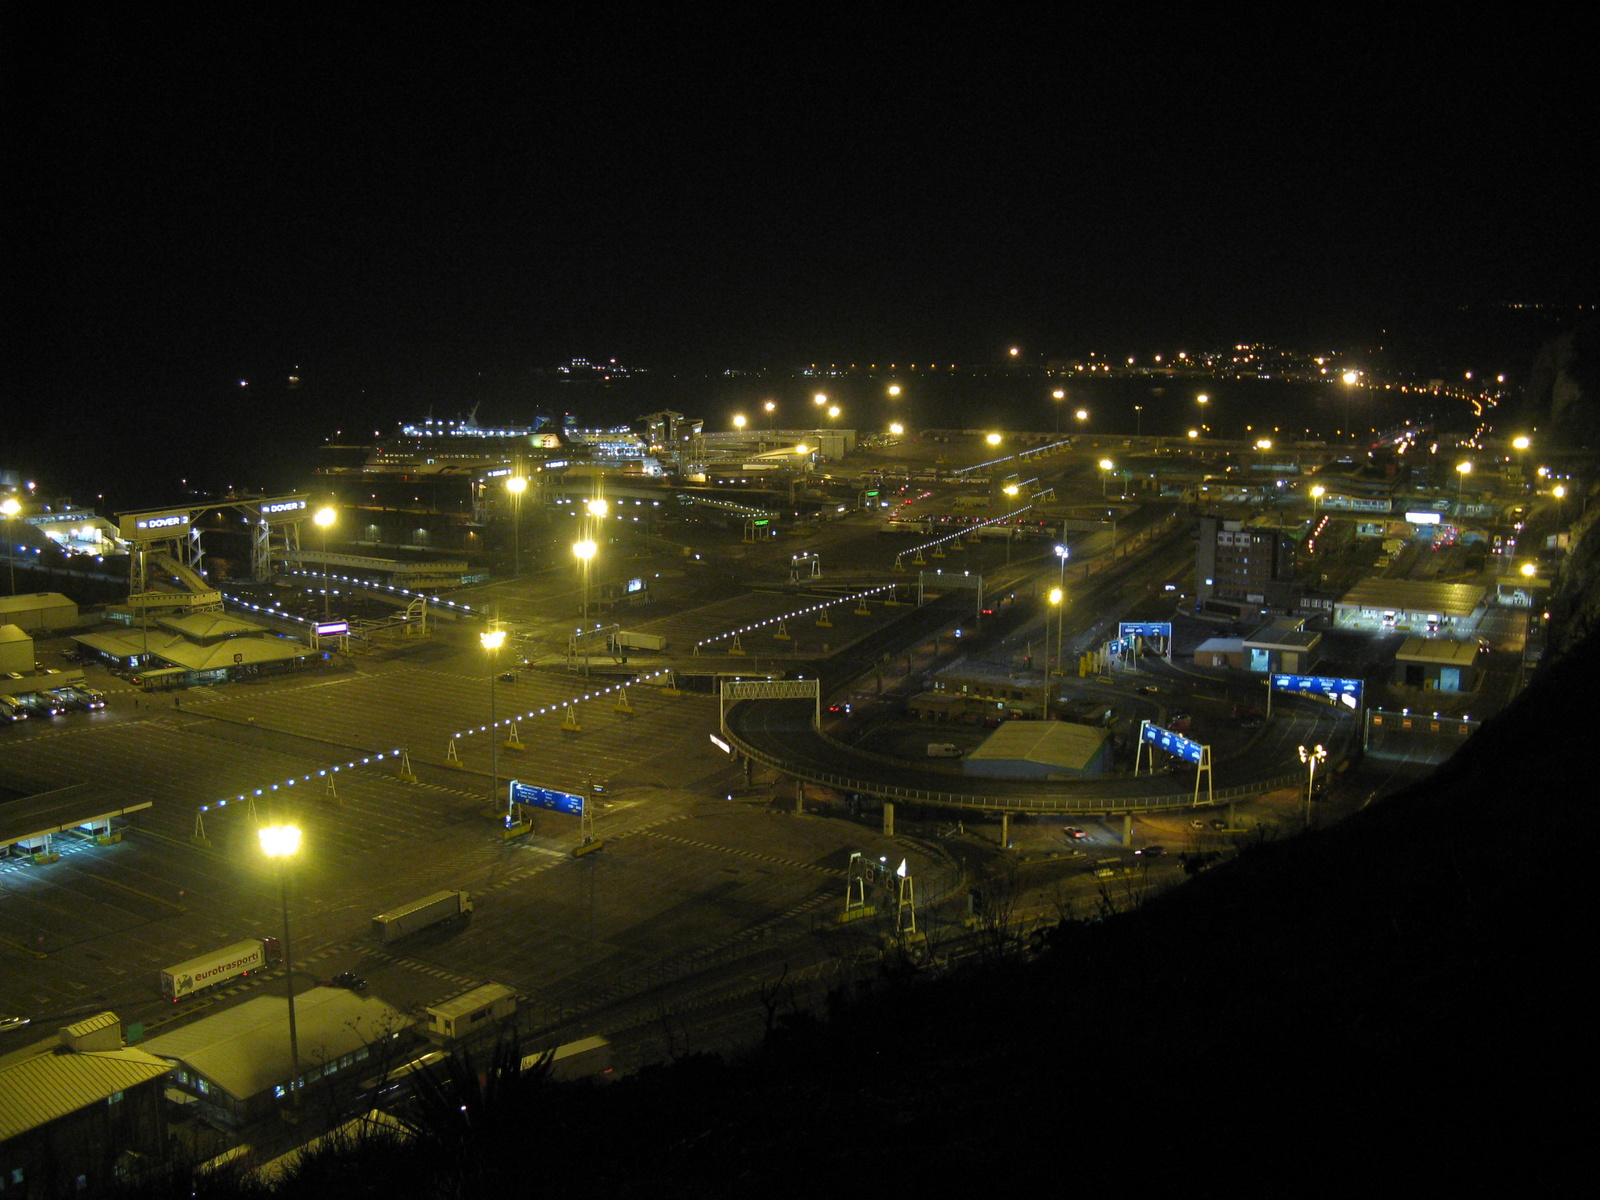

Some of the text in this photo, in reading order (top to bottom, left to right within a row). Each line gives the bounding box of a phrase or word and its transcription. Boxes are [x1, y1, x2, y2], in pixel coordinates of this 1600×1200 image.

[270, 501, 306, 512] DOVER 3
[149, 515, 189, 528] DOVER 2
[195, 951, 259, 981] eurotrasporti
